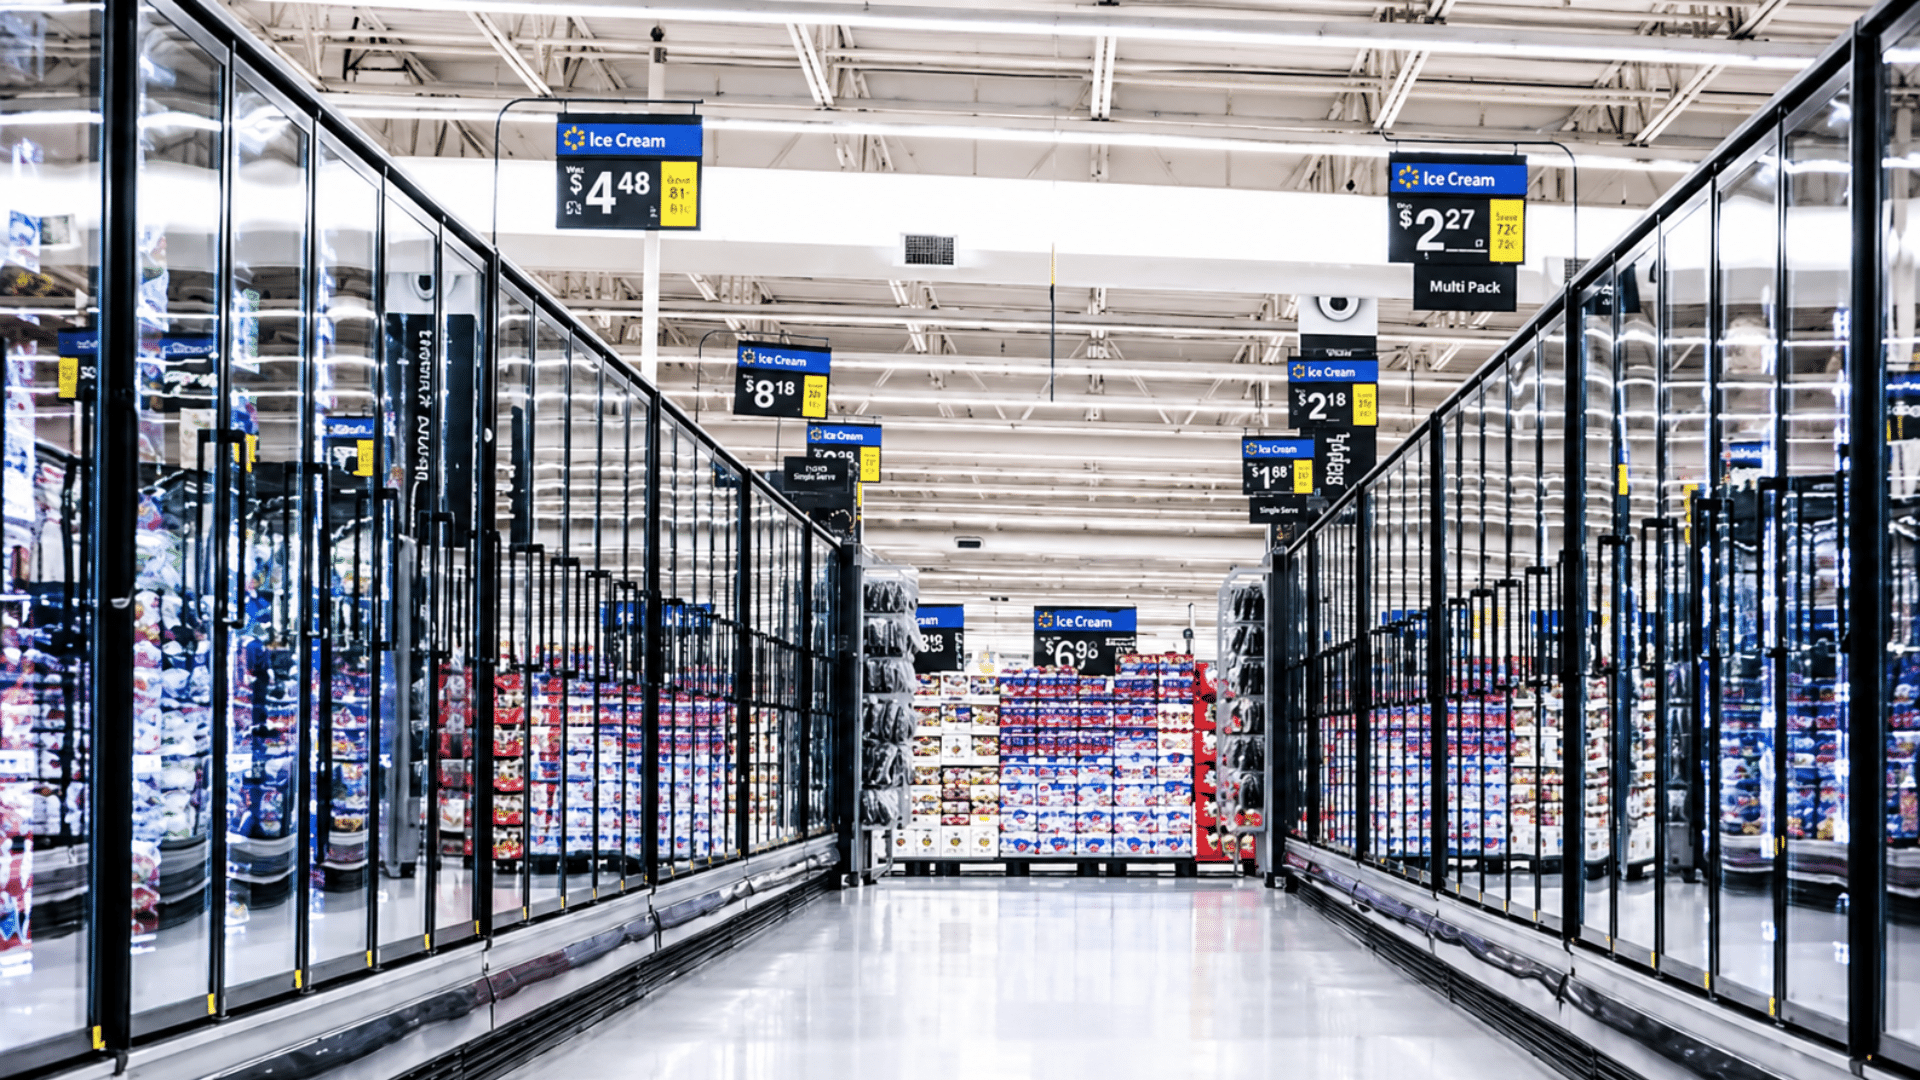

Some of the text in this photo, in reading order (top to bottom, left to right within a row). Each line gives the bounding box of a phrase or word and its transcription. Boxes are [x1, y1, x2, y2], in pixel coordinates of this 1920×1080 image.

[589, 131, 666, 149] Ice Cream
[1423, 171, 1496, 188] Ice Cream
[1429, 280, 1501, 294] Multi Pack
[758, 353, 807, 367] Ice Cream
[1307, 366, 1356, 378] Ice Cream
[823, 429, 864, 441] Ice Cream
[1258, 444, 1298, 454] Ice Cream
[1259, 506, 1299, 515] Single Serve
[1056, 615, 1113, 628] Ice Cream
